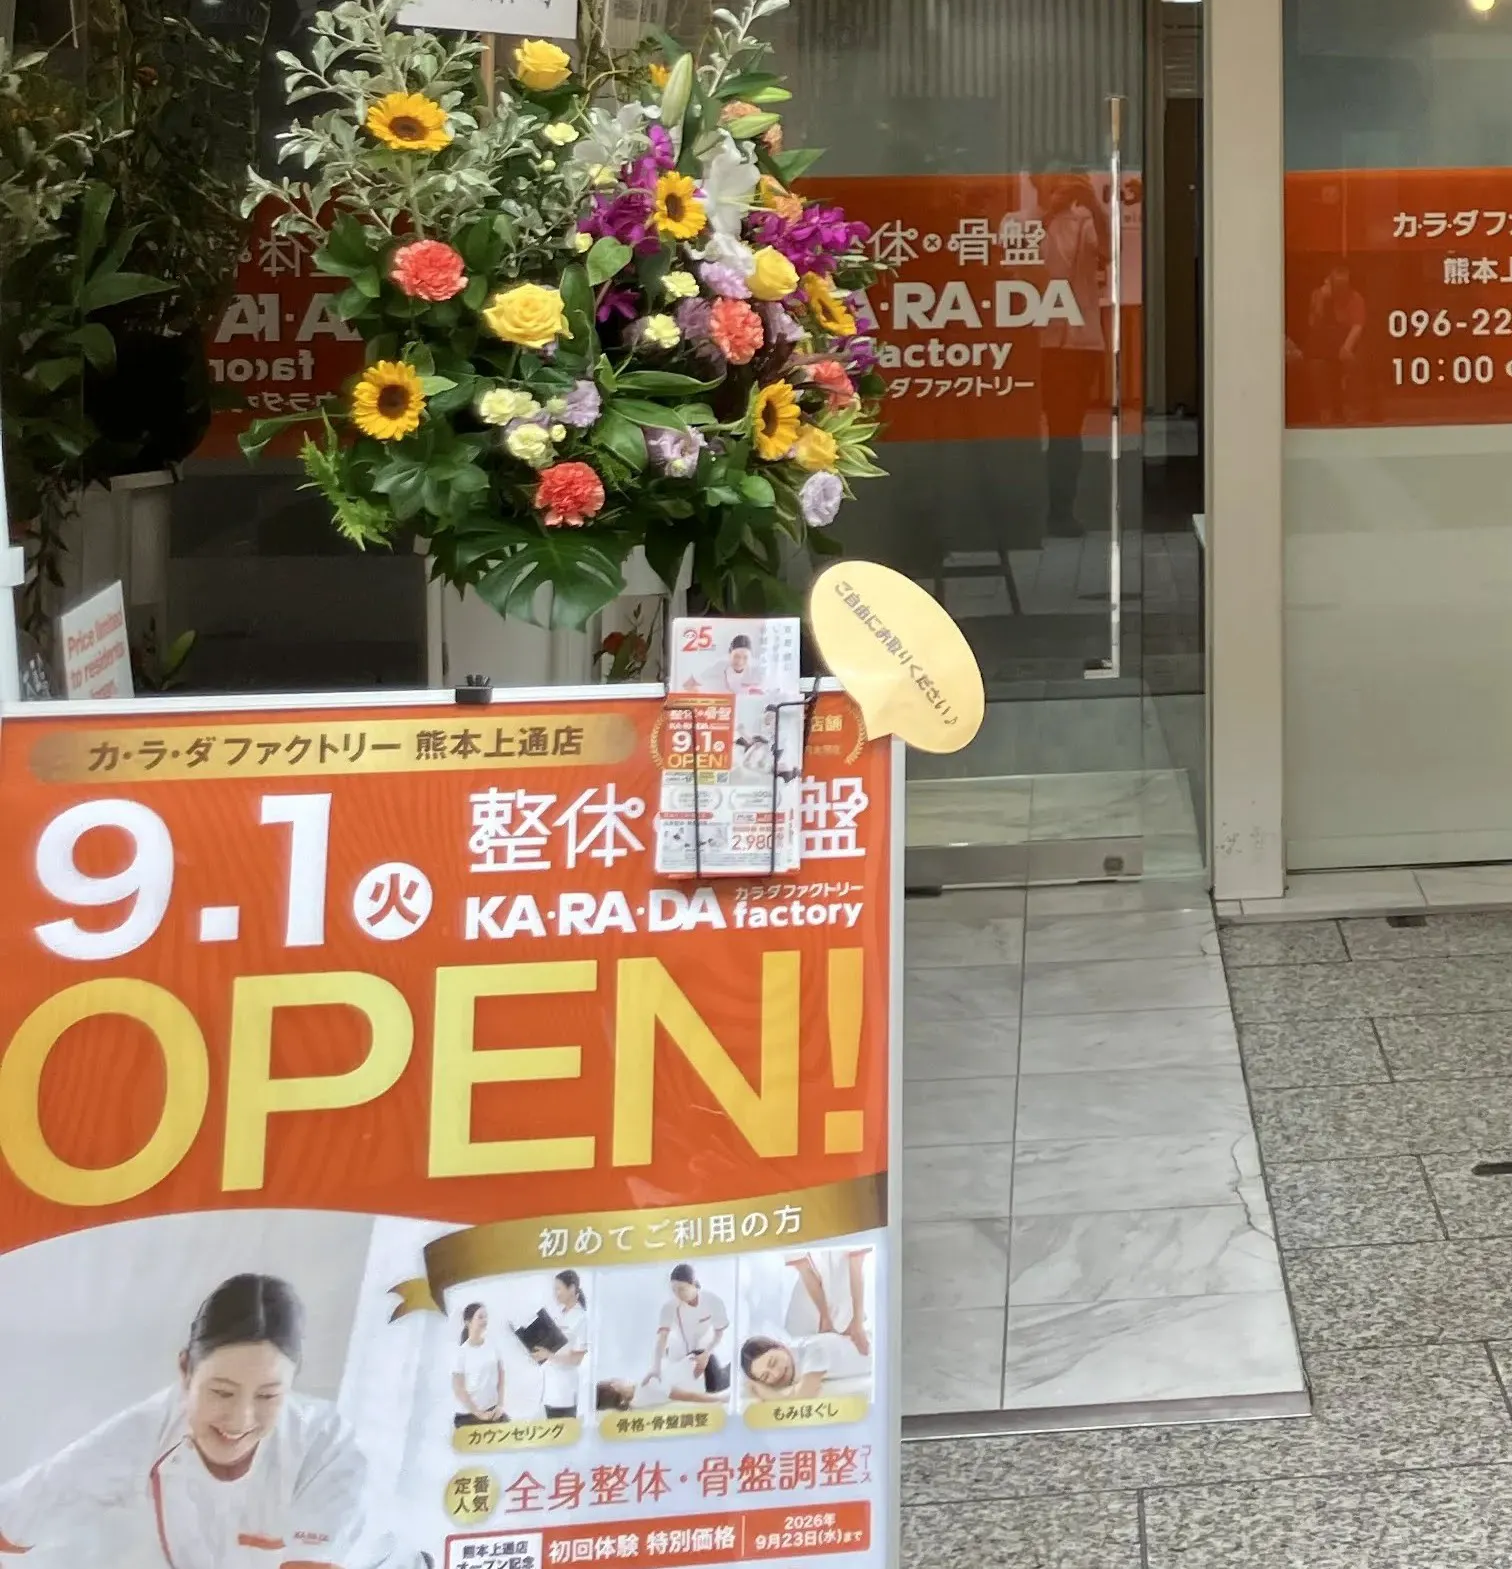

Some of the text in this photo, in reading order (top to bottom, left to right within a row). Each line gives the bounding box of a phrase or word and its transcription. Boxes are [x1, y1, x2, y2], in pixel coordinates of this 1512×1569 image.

[1392, 355, 1494, 385] 10:00
[415, 725, 584, 762] 熊本上通店
[667, 754, 729, 770] OPEN!
[34, 793, 332, 961] 9.1
[733, 898, 864, 930] factory
[0, 947, 865, 1207] OPEN!
[538, 1204, 804, 1259] 初めてご利用の方
[615, 1411, 711, 1434] 骨格・骨盤調整
[771, 1402, 839, 1421] もみほぐし
[467, 1422, 565, 1446] カウンセリング
[454, 1475, 490, 1496] 定番
[453, 1494, 490, 1514] 人気
[784, 1512, 836, 1531] 2026年
[461, 1540, 529, 1559] 熊本上通店
[548, 1524, 736, 1562] 初回体験 特別価格
